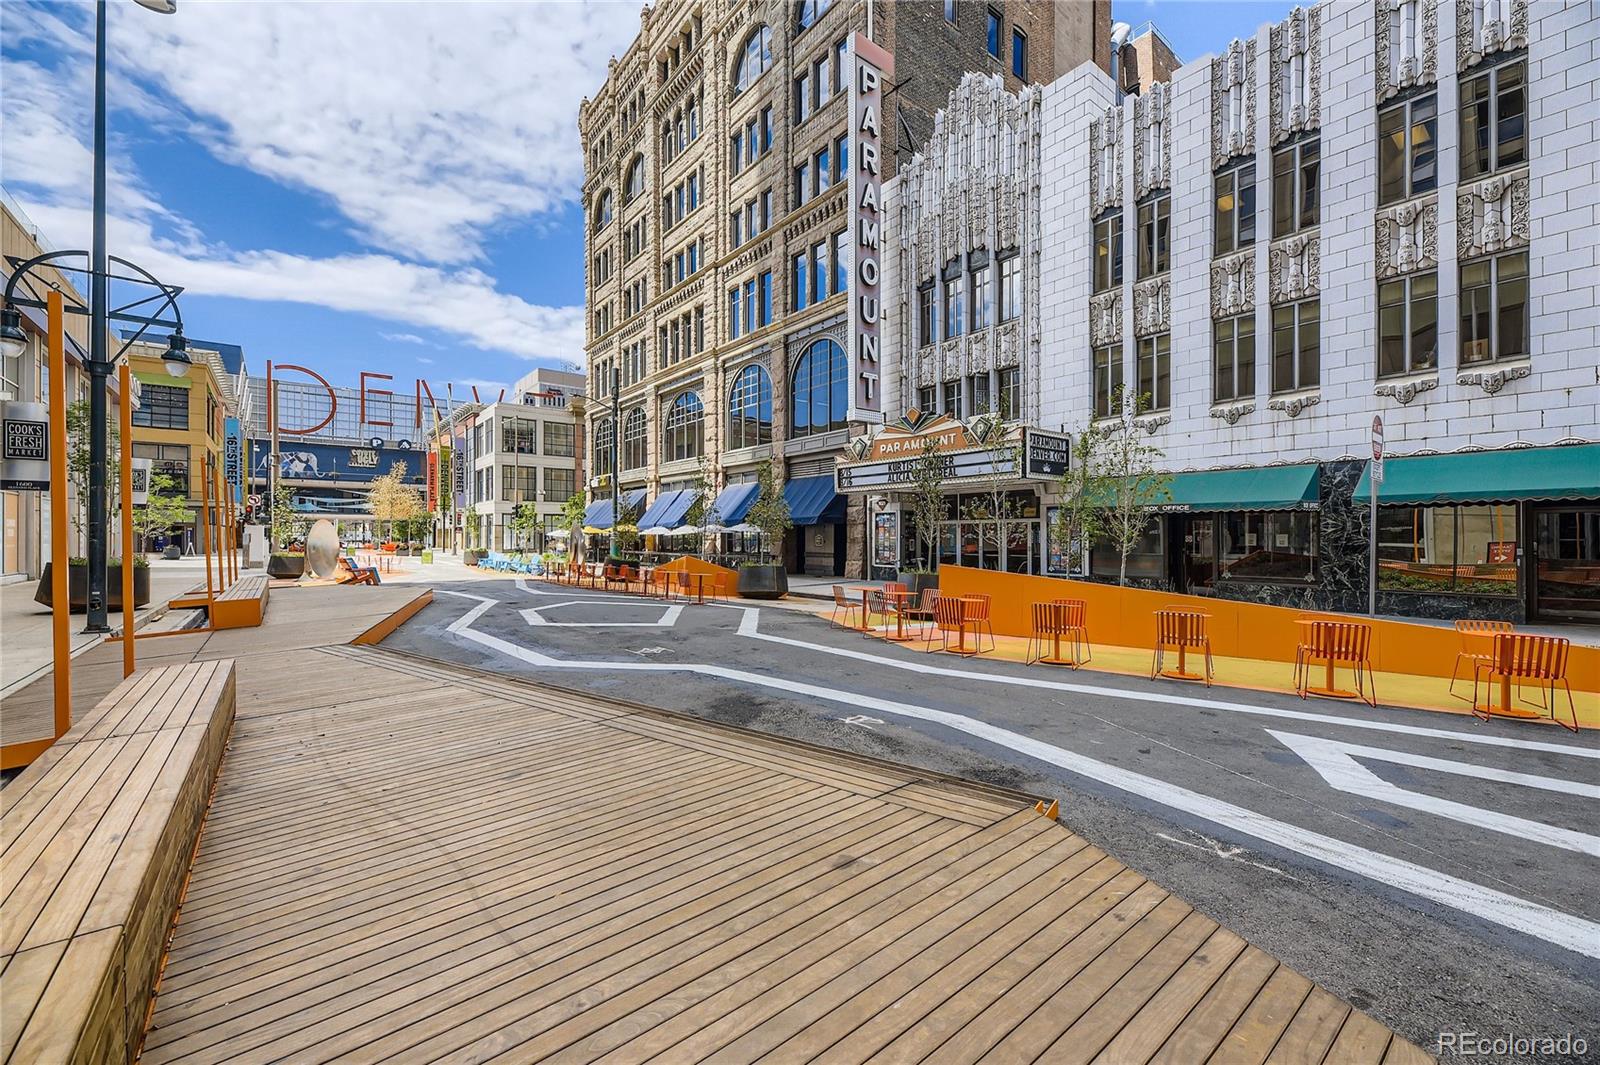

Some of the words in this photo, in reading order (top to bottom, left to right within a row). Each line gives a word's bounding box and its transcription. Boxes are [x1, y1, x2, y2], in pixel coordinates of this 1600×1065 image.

[859, 65, 878, 400] PARAMOUNT
[8, 424, 42, 435] COOK'S
[8, 436, 42, 447] FRESH
[456, 467, 464, 494] STREET
[887, 471, 911, 482] ALICIA
